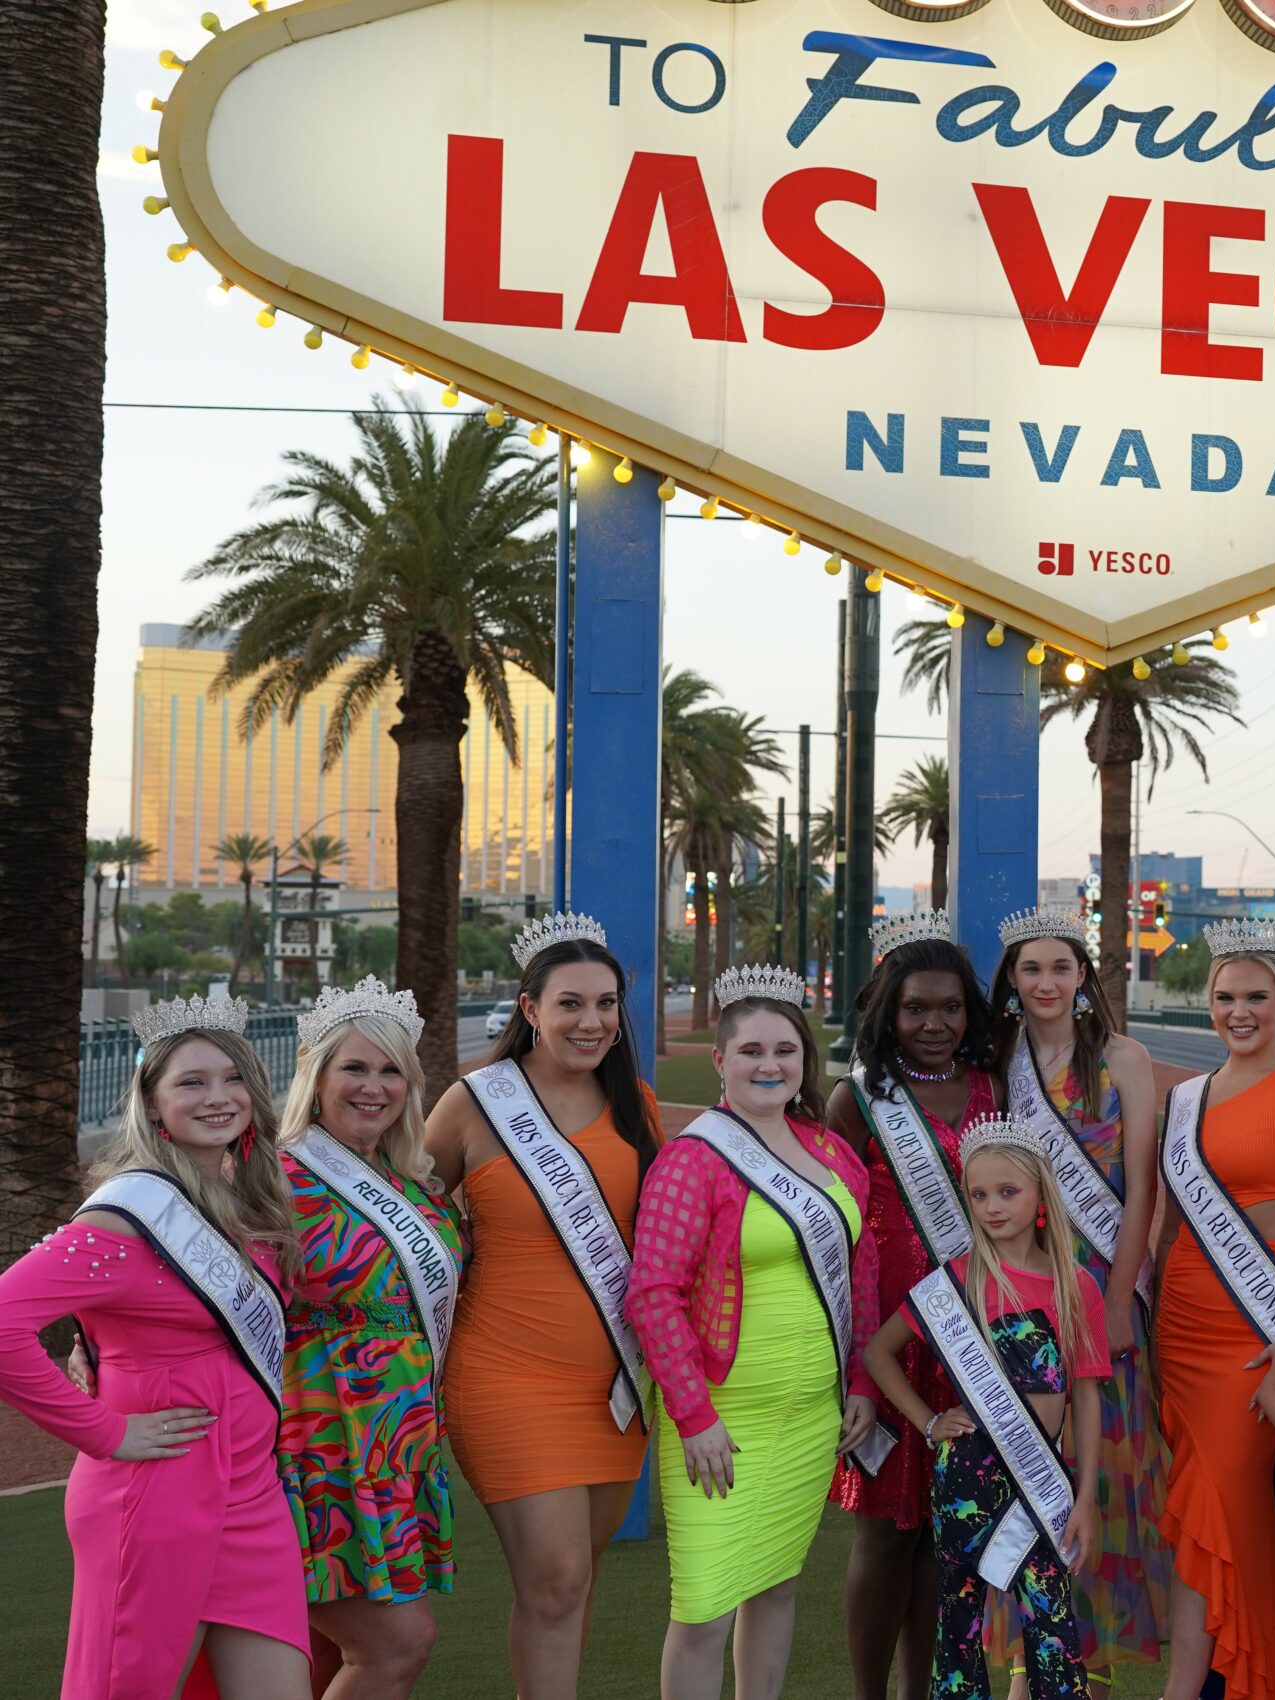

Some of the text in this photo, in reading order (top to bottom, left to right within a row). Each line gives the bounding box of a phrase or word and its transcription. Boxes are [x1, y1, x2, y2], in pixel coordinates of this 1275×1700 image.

[584, 34, 726, 114] TO
[443, 134, 886, 350] LAS
[1089, 550, 1170, 575] YESCO
[505, 1111, 542, 1144] MRS
[530, 1144, 581, 1208] AMERICA
[885, 1111, 909, 1131] MS
[767, 1172, 801, 1200] MISS
[798, 1196, 834, 1245] NORTH
[894, 1132, 960, 1238] REVOLUTIONARY
[1170, 1135, 1191, 1177] MISS
[1185, 1176, 1213, 1215] USA
[353, 1181, 448, 1295] REVOLUTIONARY
[940, 1313, 964, 1334] Little
[945, 1324, 969, 1344] Miss
[956, 1341, 1066, 1507] NORTH AMERICA REVOLUTIONARY
